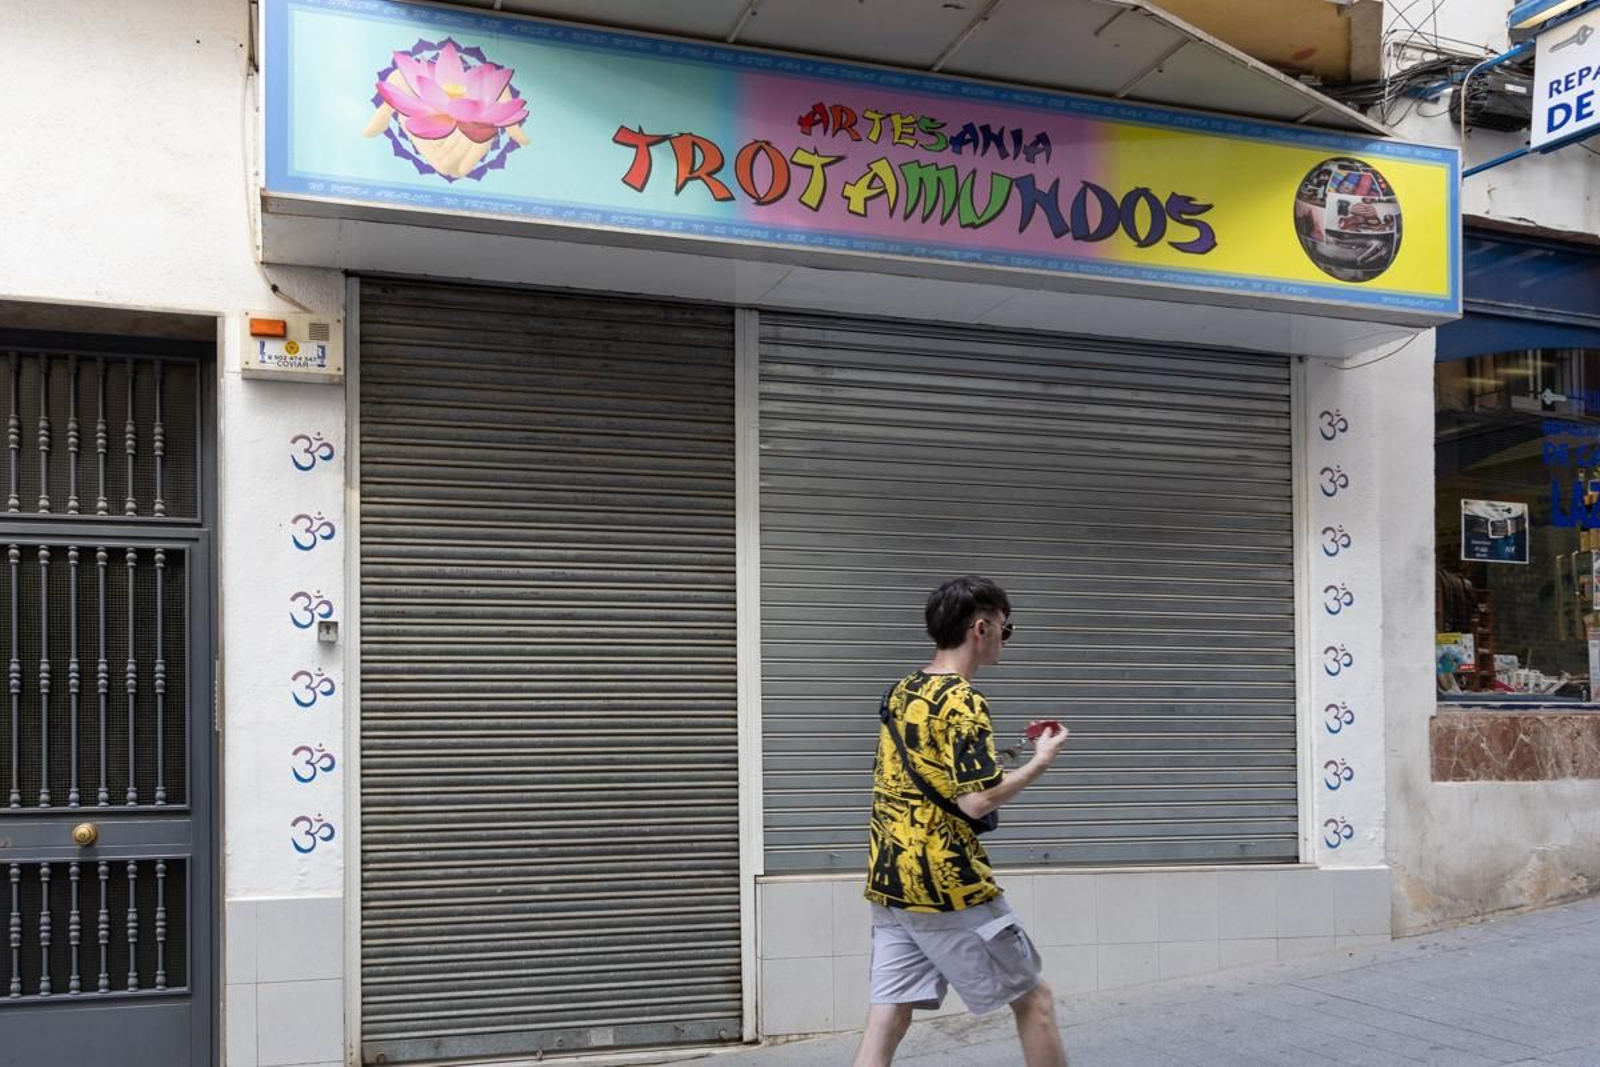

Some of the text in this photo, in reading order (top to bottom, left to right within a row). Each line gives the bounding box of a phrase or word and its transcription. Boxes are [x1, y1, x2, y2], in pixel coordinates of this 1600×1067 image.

[798, 102, 1052, 164] ARTESANIA
[1546, 89, 1595, 133] DE
[612, 125, 1218, 255] TROTAMUNDOS
